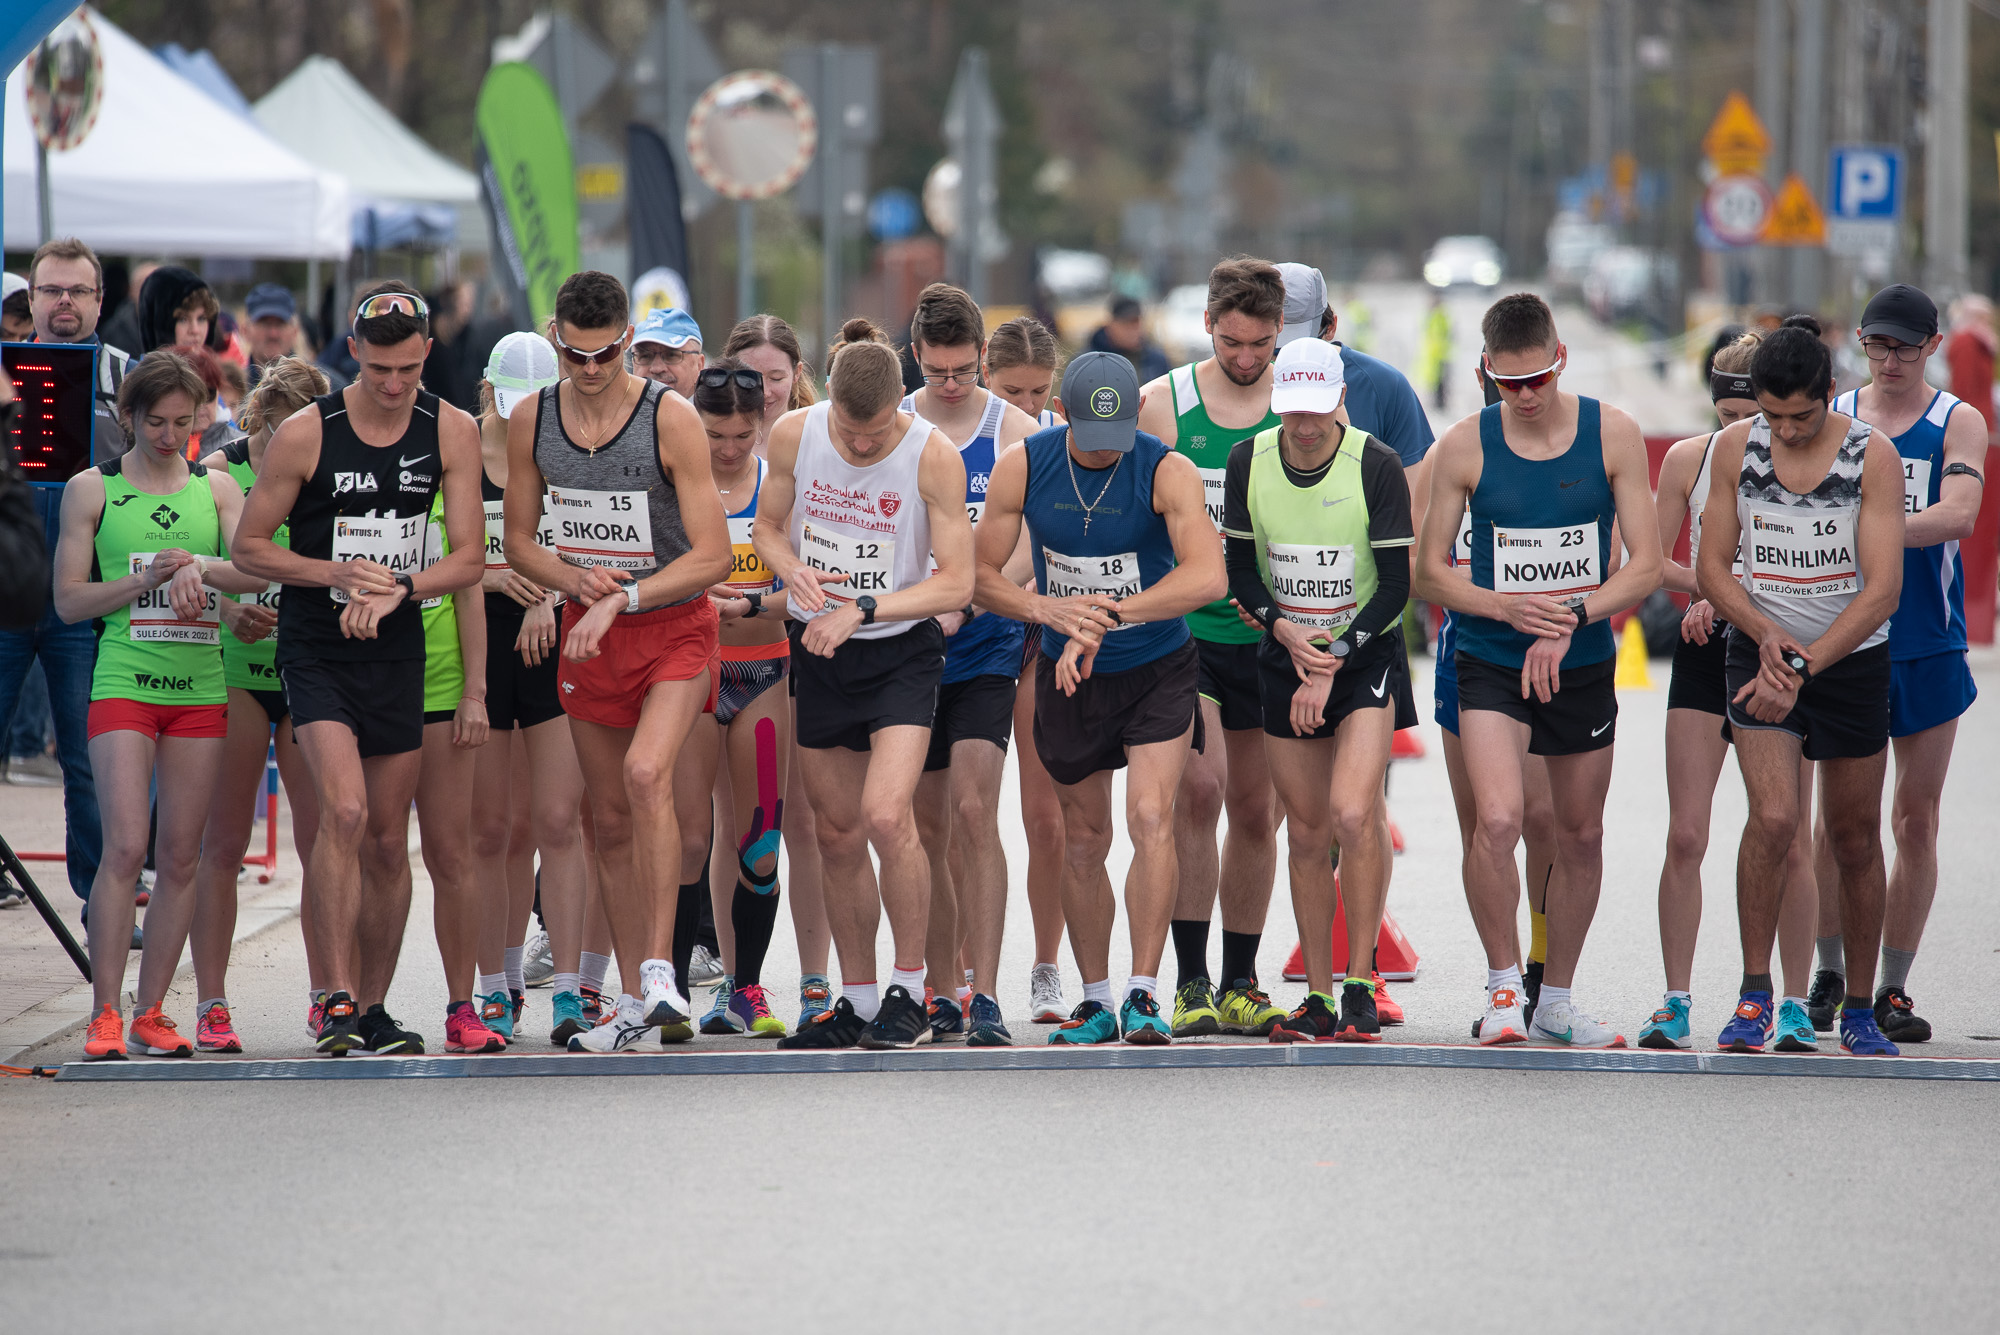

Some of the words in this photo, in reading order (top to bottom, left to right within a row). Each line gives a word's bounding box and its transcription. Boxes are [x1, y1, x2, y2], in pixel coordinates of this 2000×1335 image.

[1840, 153, 1891, 221] P
[1282, 371, 1326, 382] LATVIA
[559, 497, 592, 508] INTUIS.PL
[609, 495, 632, 511] 15
[144, 531, 190, 540] ATHLETICS
[347, 528, 382, 538] INTUIS.PL
[400, 520, 416, 539] 11
[561, 520, 641, 543] SIKORA
[1762, 522, 1795, 535] INTUIS.PL
[1812, 519, 1837, 536] 16
[810, 534, 839, 552] INTUIS.PL
[855, 543, 879, 559] 12
[1507, 538, 1542, 548] INTUIS.PL
[1560, 529, 1584, 547] 23
[616, 560, 639, 568] 2022
[1316, 550, 1340, 567] 17
[1755, 544, 1788, 567] BEN
[1791, 546, 1852, 568] HLIMA
[1100, 558, 1124, 576] 18
[1503, 557, 1592, 582] NOWAK
[1759, 582, 1814, 596] SULEJÓWEK
[1815, 583, 1840, 594] 2022
[1320, 615, 1342, 627] 2022
[136, 627, 190, 639] SULEJÓWEK
[191, 631, 208, 640] 2022
[134, 673, 194, 691] WeNet
